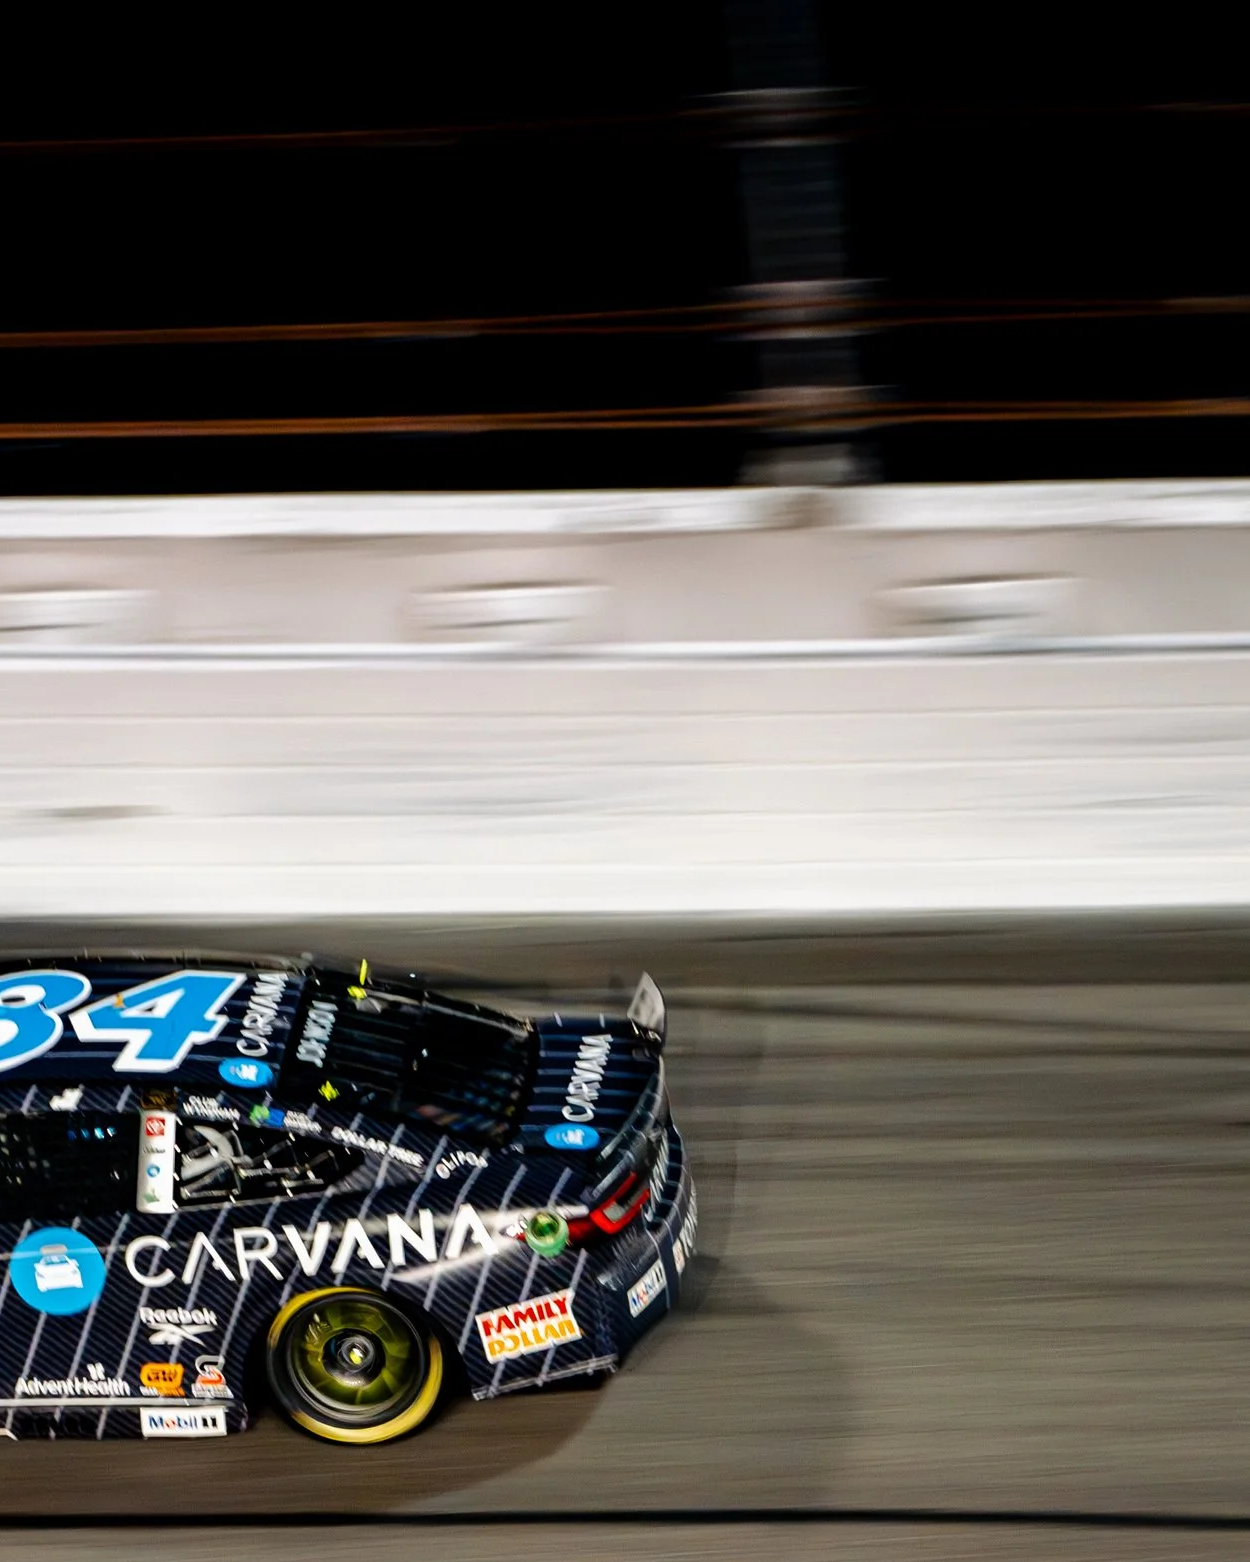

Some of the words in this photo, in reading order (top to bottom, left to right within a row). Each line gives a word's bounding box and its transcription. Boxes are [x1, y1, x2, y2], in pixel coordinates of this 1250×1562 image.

[236, 973, 288, 1057] CARVANA
[561, 1033, 613, 1122] CARVANA
[125, 1203, 499, 1288] CARVANA
[481, 1297, 567, 1337] FAMILY
[487, 1319, 576, 1357] DOLLAR
[15, 1376, 131, 1397] AdventHealth
[149, 1415, 198, 1431] Mobil
